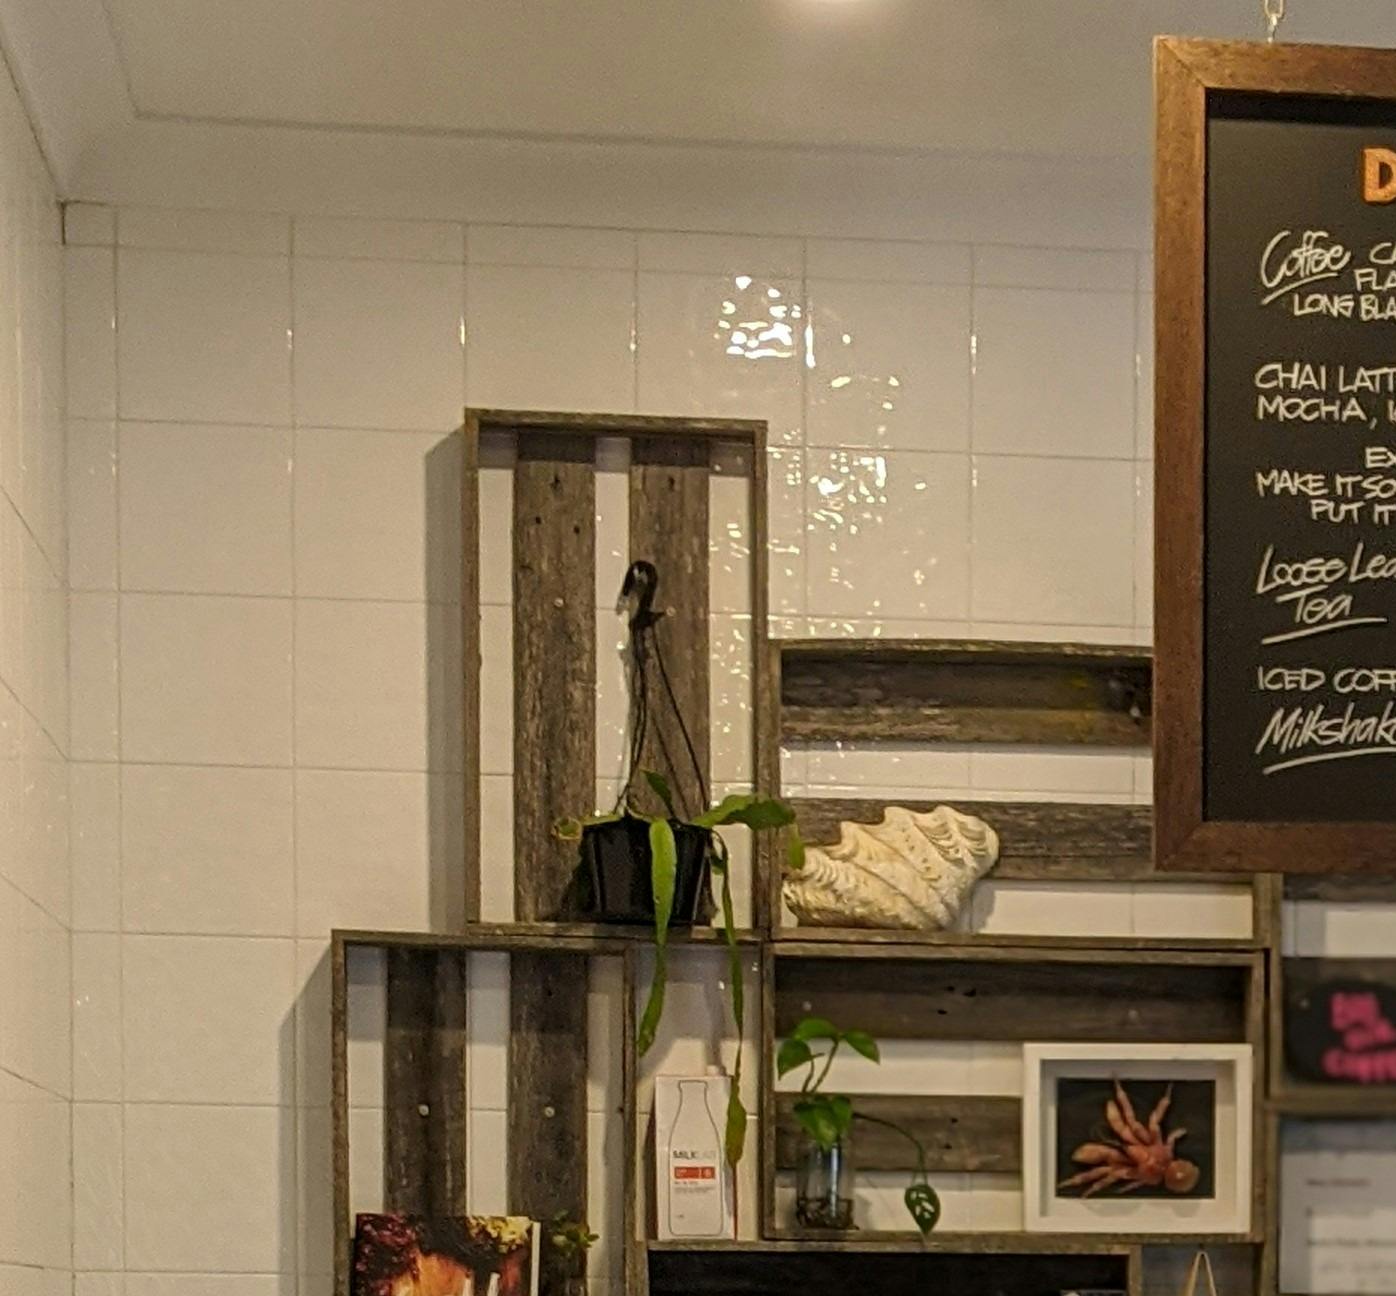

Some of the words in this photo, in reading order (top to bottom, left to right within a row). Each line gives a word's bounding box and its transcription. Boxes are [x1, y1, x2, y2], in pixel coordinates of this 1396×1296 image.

[1261, 230, 1351, 288] Coffee
[1293, 293, 1354, 318] LONG
[1255, 362, 1327, 391] CHAI
[1257, 394, 1378, 429] MOCHA,
[1256, 469, 1329, 497] MAKE
[1335, 473, 1364, 498] IT
[1309, 499, 1366, 525] PUT
[1256, 544, 1348, 594] Loose
[1275, 584, 1353, 624] Tea
[1258, 665, 1326, 691] ICED
